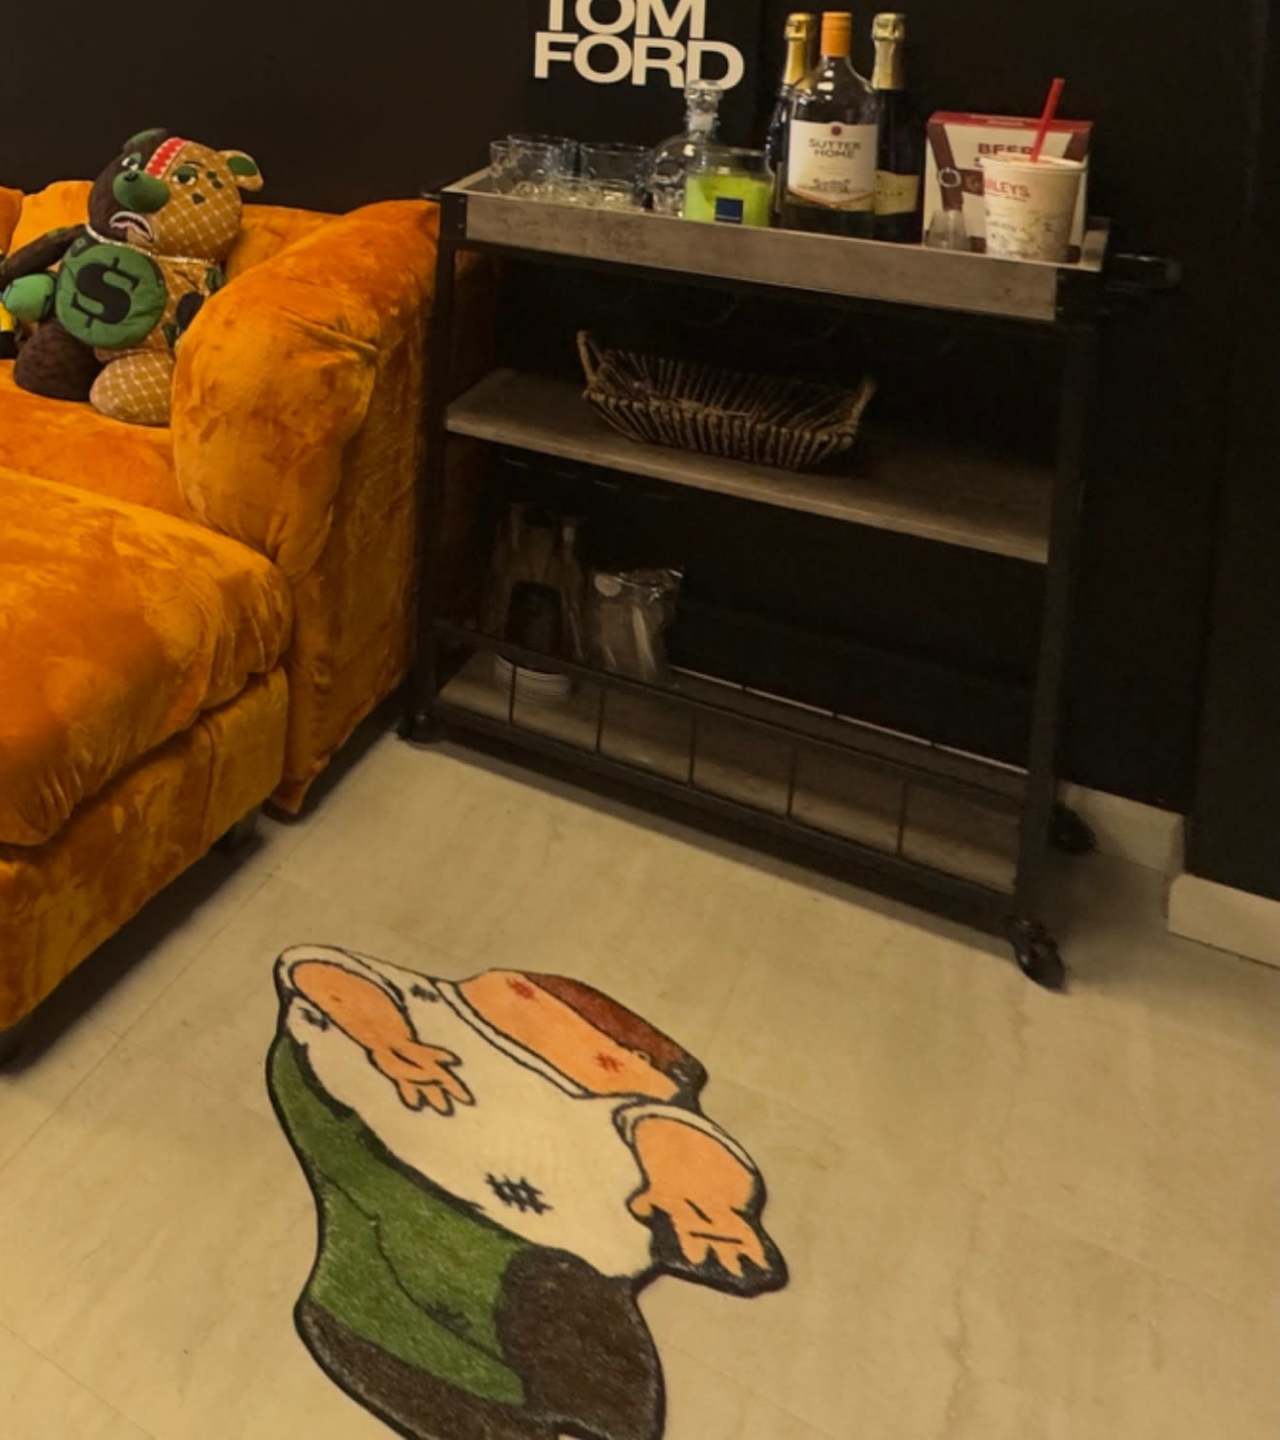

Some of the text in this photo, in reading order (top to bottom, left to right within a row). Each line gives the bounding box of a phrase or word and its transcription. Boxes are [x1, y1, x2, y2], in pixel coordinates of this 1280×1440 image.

[534, 31, 745, 91] FORD
[808, 138, 861, 150] SUTTER
[814, 149, 855, 159] HOME
